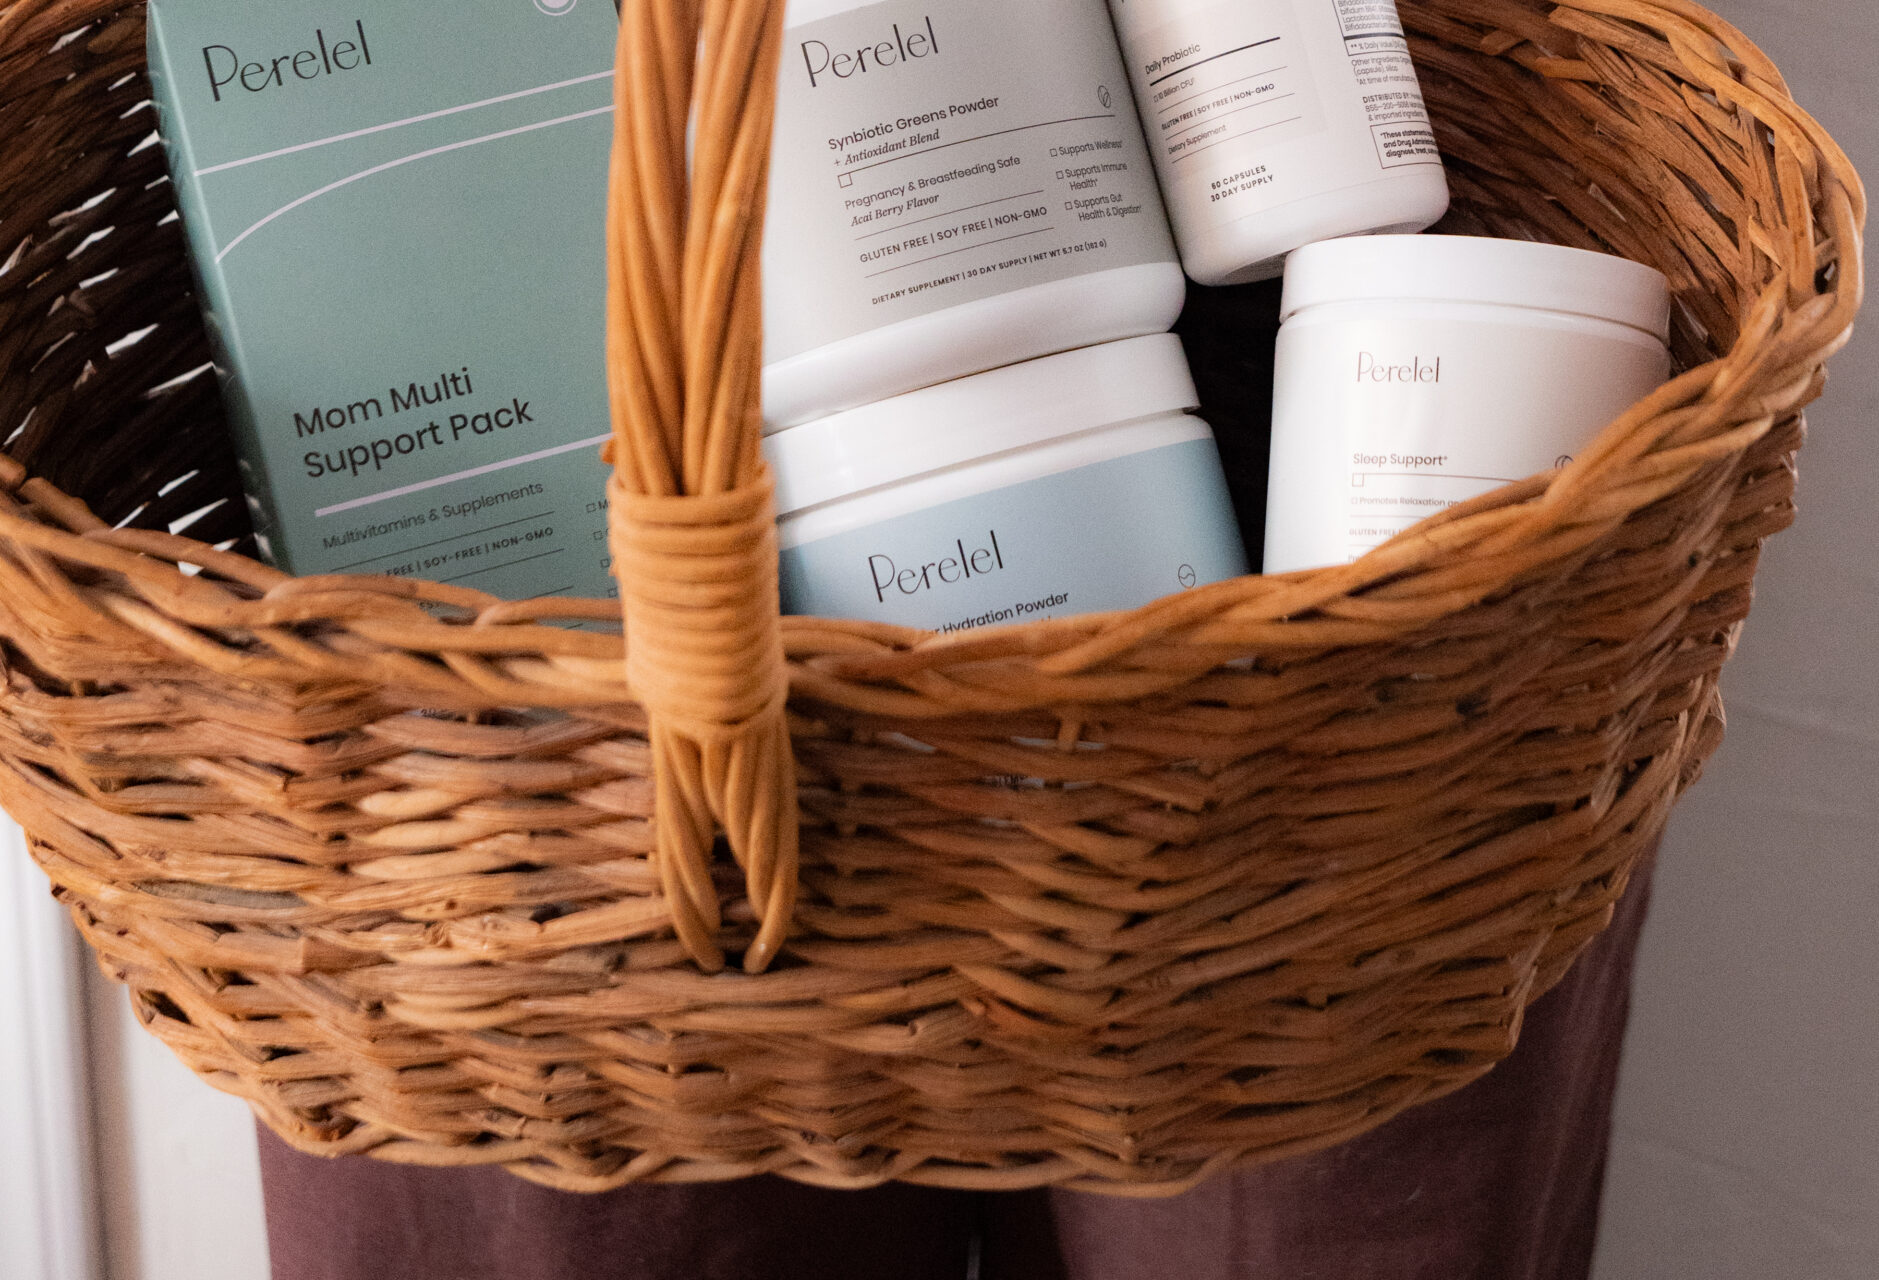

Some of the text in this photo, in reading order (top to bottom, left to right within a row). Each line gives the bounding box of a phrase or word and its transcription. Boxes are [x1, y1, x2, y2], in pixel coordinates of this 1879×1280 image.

[202, 19, 372, 102] Perelel
[800, 16, 939, 88] Perelel
[1145, 43, 1201, 75] Daily Probiotic
[828, 96, 999, 152] Synbiotic Greens Powder
[1161, 83, 1275, 131] GLUTEN FREE SOY FREE NON-GMO
[844, 138, 907, 166] Antioxidant
[909, 128, 941, 148] Blend
[1058, 142, 1095, 156] Supports
[1186, 124, 1227, 146] Supplement
[844, 154, 1022, 211] Pregnancy & Breastfeeding Safe
[1065, 162, 1128, 179] Supports Immune
[1210, 174, 1274, 202] 30 DAY SUPPLY
[1222, 165, 1267, 186] CAPSULES
[850, 194, 940, 228] Acai Berry Flavor
[1073, 193, 1124, 209] Supports Gut
[1078, 208, 1106, 222] Health
[860, 206, 1048, 264] GLUTEN FREE SOY FREE NON-GMO
[872, 288, 907, 305] DIETARY
[908, 273, 961, 294] SUPPLEMENT
[967, 268, 978, 278] 30
[979, 264, 997, 275] DAY
[998, 256, 1028, 270] SUPPLY
[1033, 252, 1048, 262] NET
[1048, 249, 1061, 258] WT
[1074, 244, 1084, 252] OZ
[1357, 351, 1441, 384] Perelel
[293, 366, 474, 438] Mom Multi
[303, 398, 534, 478] Support Pack
[1353, 452, 1387, 468] Sleep
[322, 483, 544, 550] Multivitamins & Supplements
[1359, 496, 1399, 506] Promotes
[1399, 497, 1446, 507] Relaxation
[424, 545, 482, 569] SOY-FREE
[492, 526, 554, 551] NON-GMO
[1348, 527, 1377, 536] GLUTEN
[867, 530, 1004, 603] Perelel
[942, 592, 1069, 635] Hydration Powder
